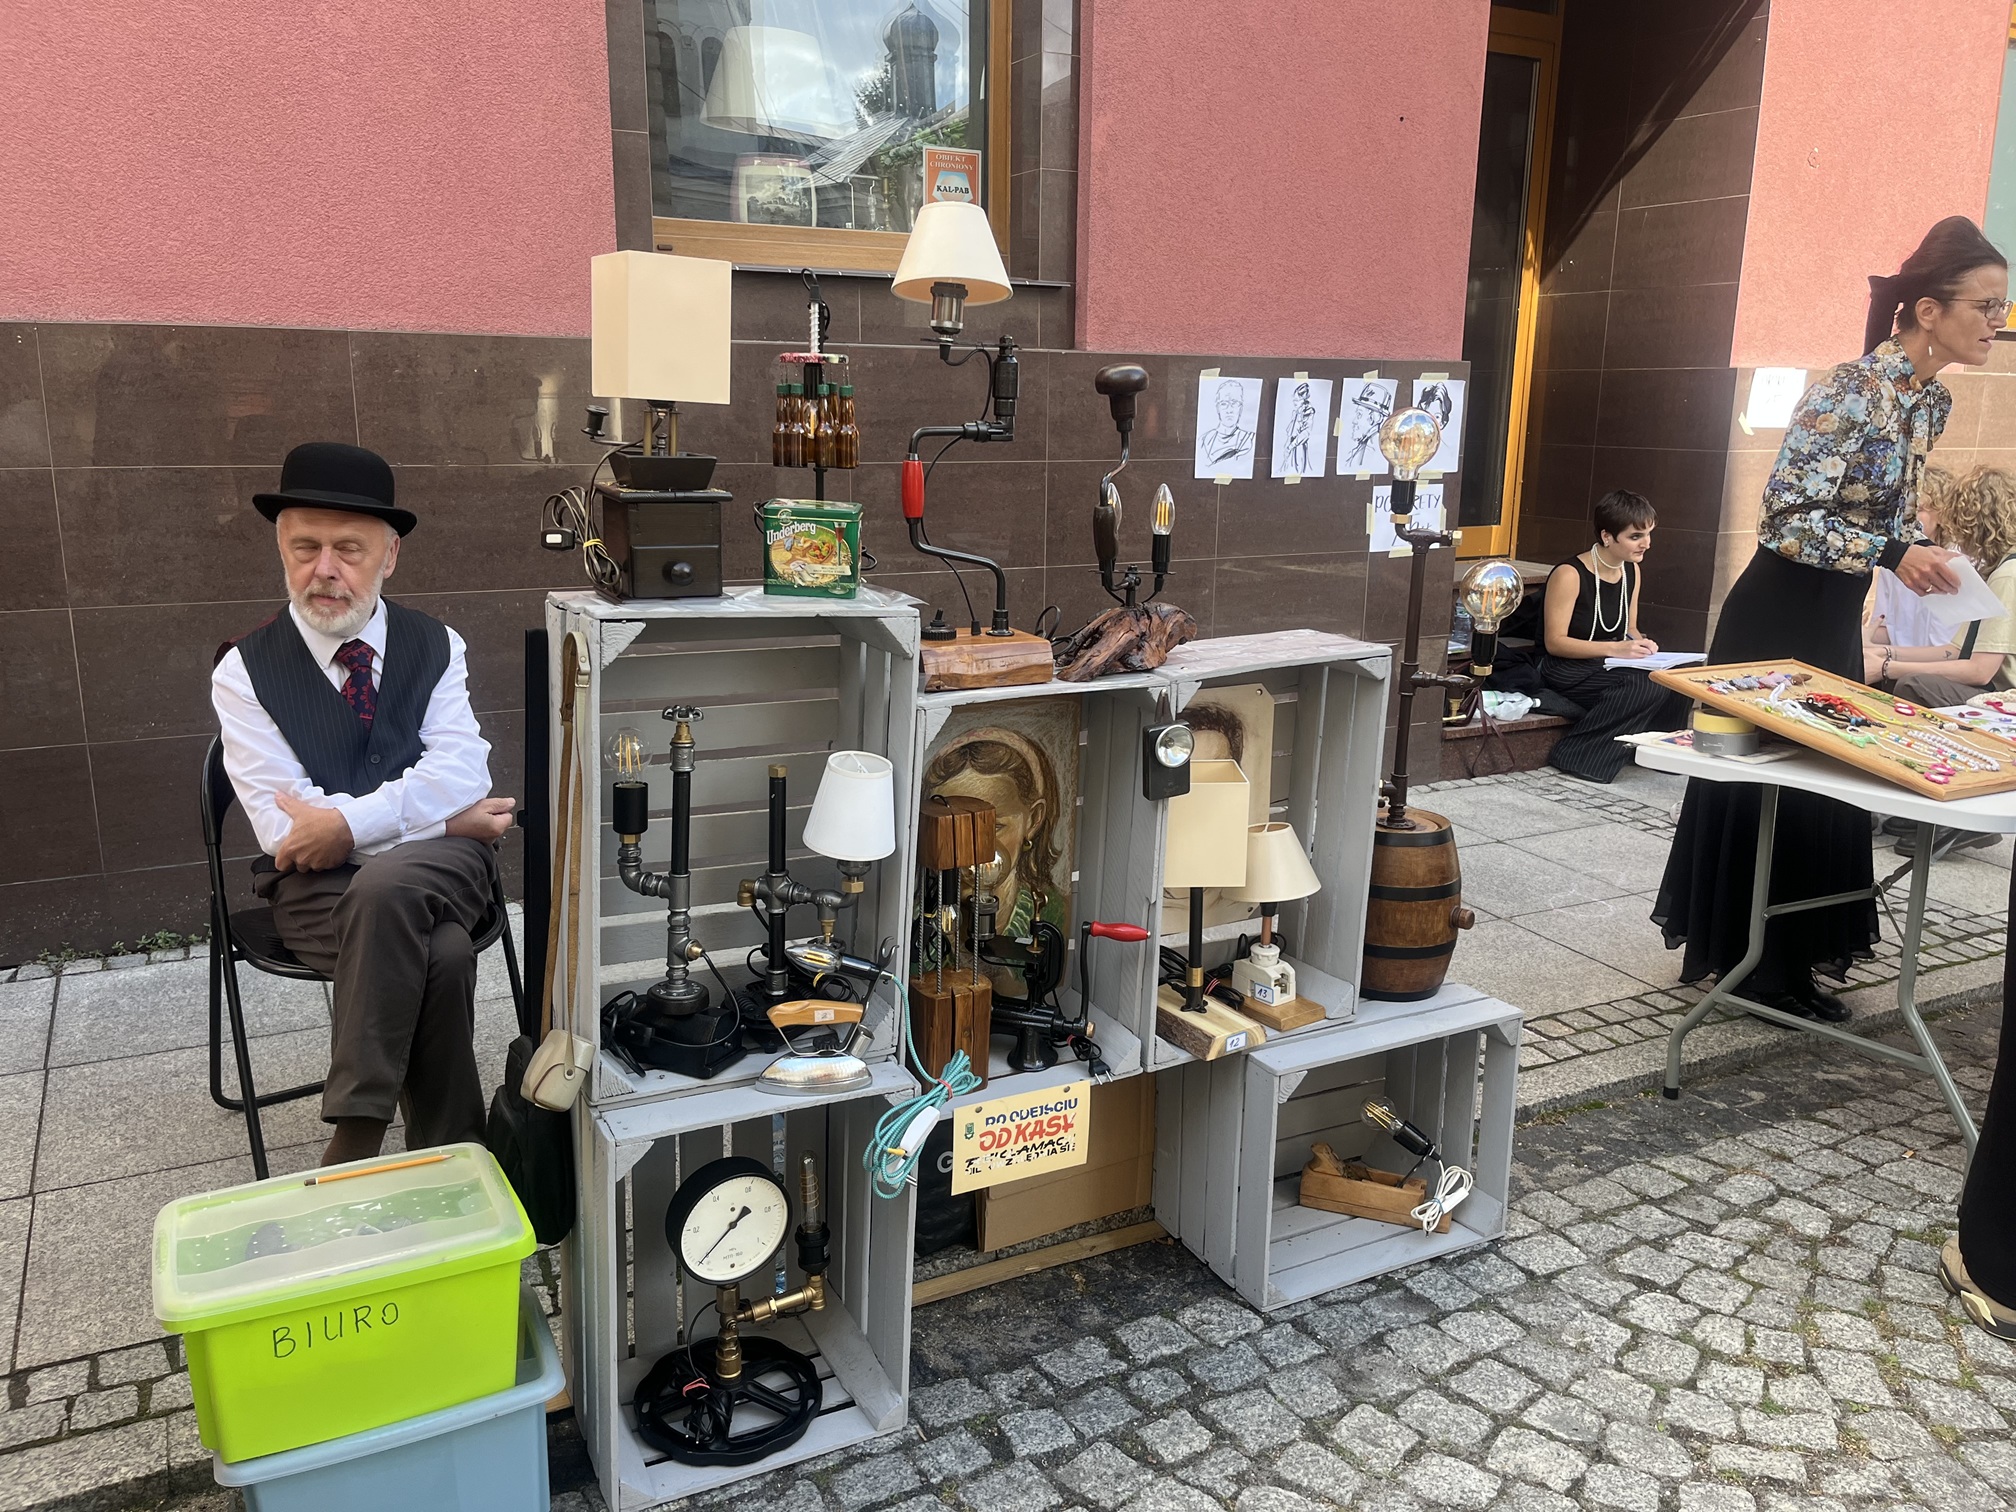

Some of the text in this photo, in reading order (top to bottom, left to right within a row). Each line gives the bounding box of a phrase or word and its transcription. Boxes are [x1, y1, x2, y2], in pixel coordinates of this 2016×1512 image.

[930, 160, 974, 171] CHRONIONY
[936, 154, 966, 162] OBIEKT
[937, 185, 969, 194] KAL-PAB
[1375, 494, 1441, 513] PORETY
[766, 521, 817, 545] Underberg
[272, 1302, 399, 1359] BIURO
